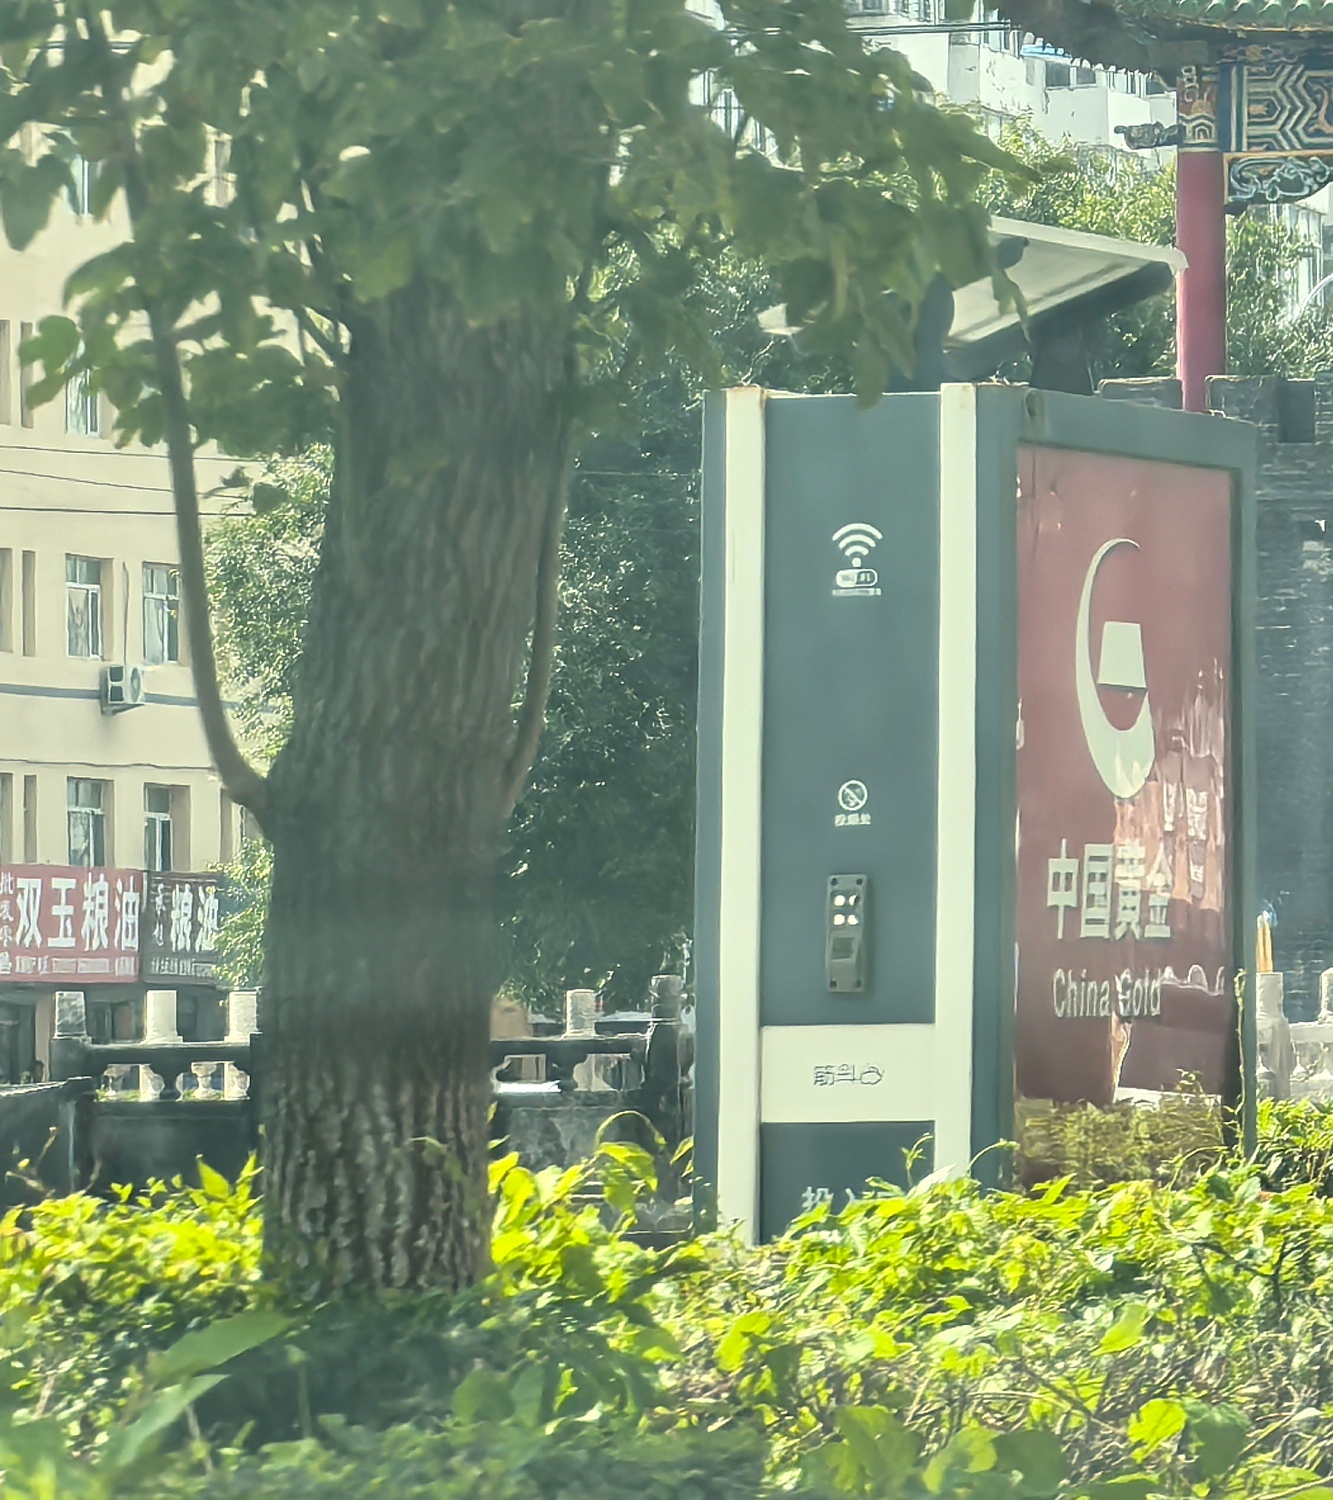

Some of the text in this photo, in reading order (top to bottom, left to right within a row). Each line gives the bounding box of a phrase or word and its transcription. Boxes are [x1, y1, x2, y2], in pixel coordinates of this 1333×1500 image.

[16, 872, 140, 951] 双玉粮油
[1047, 838, 1172, 939] 中国黄金
[1053, 968, 1161, 1020] China Gold
